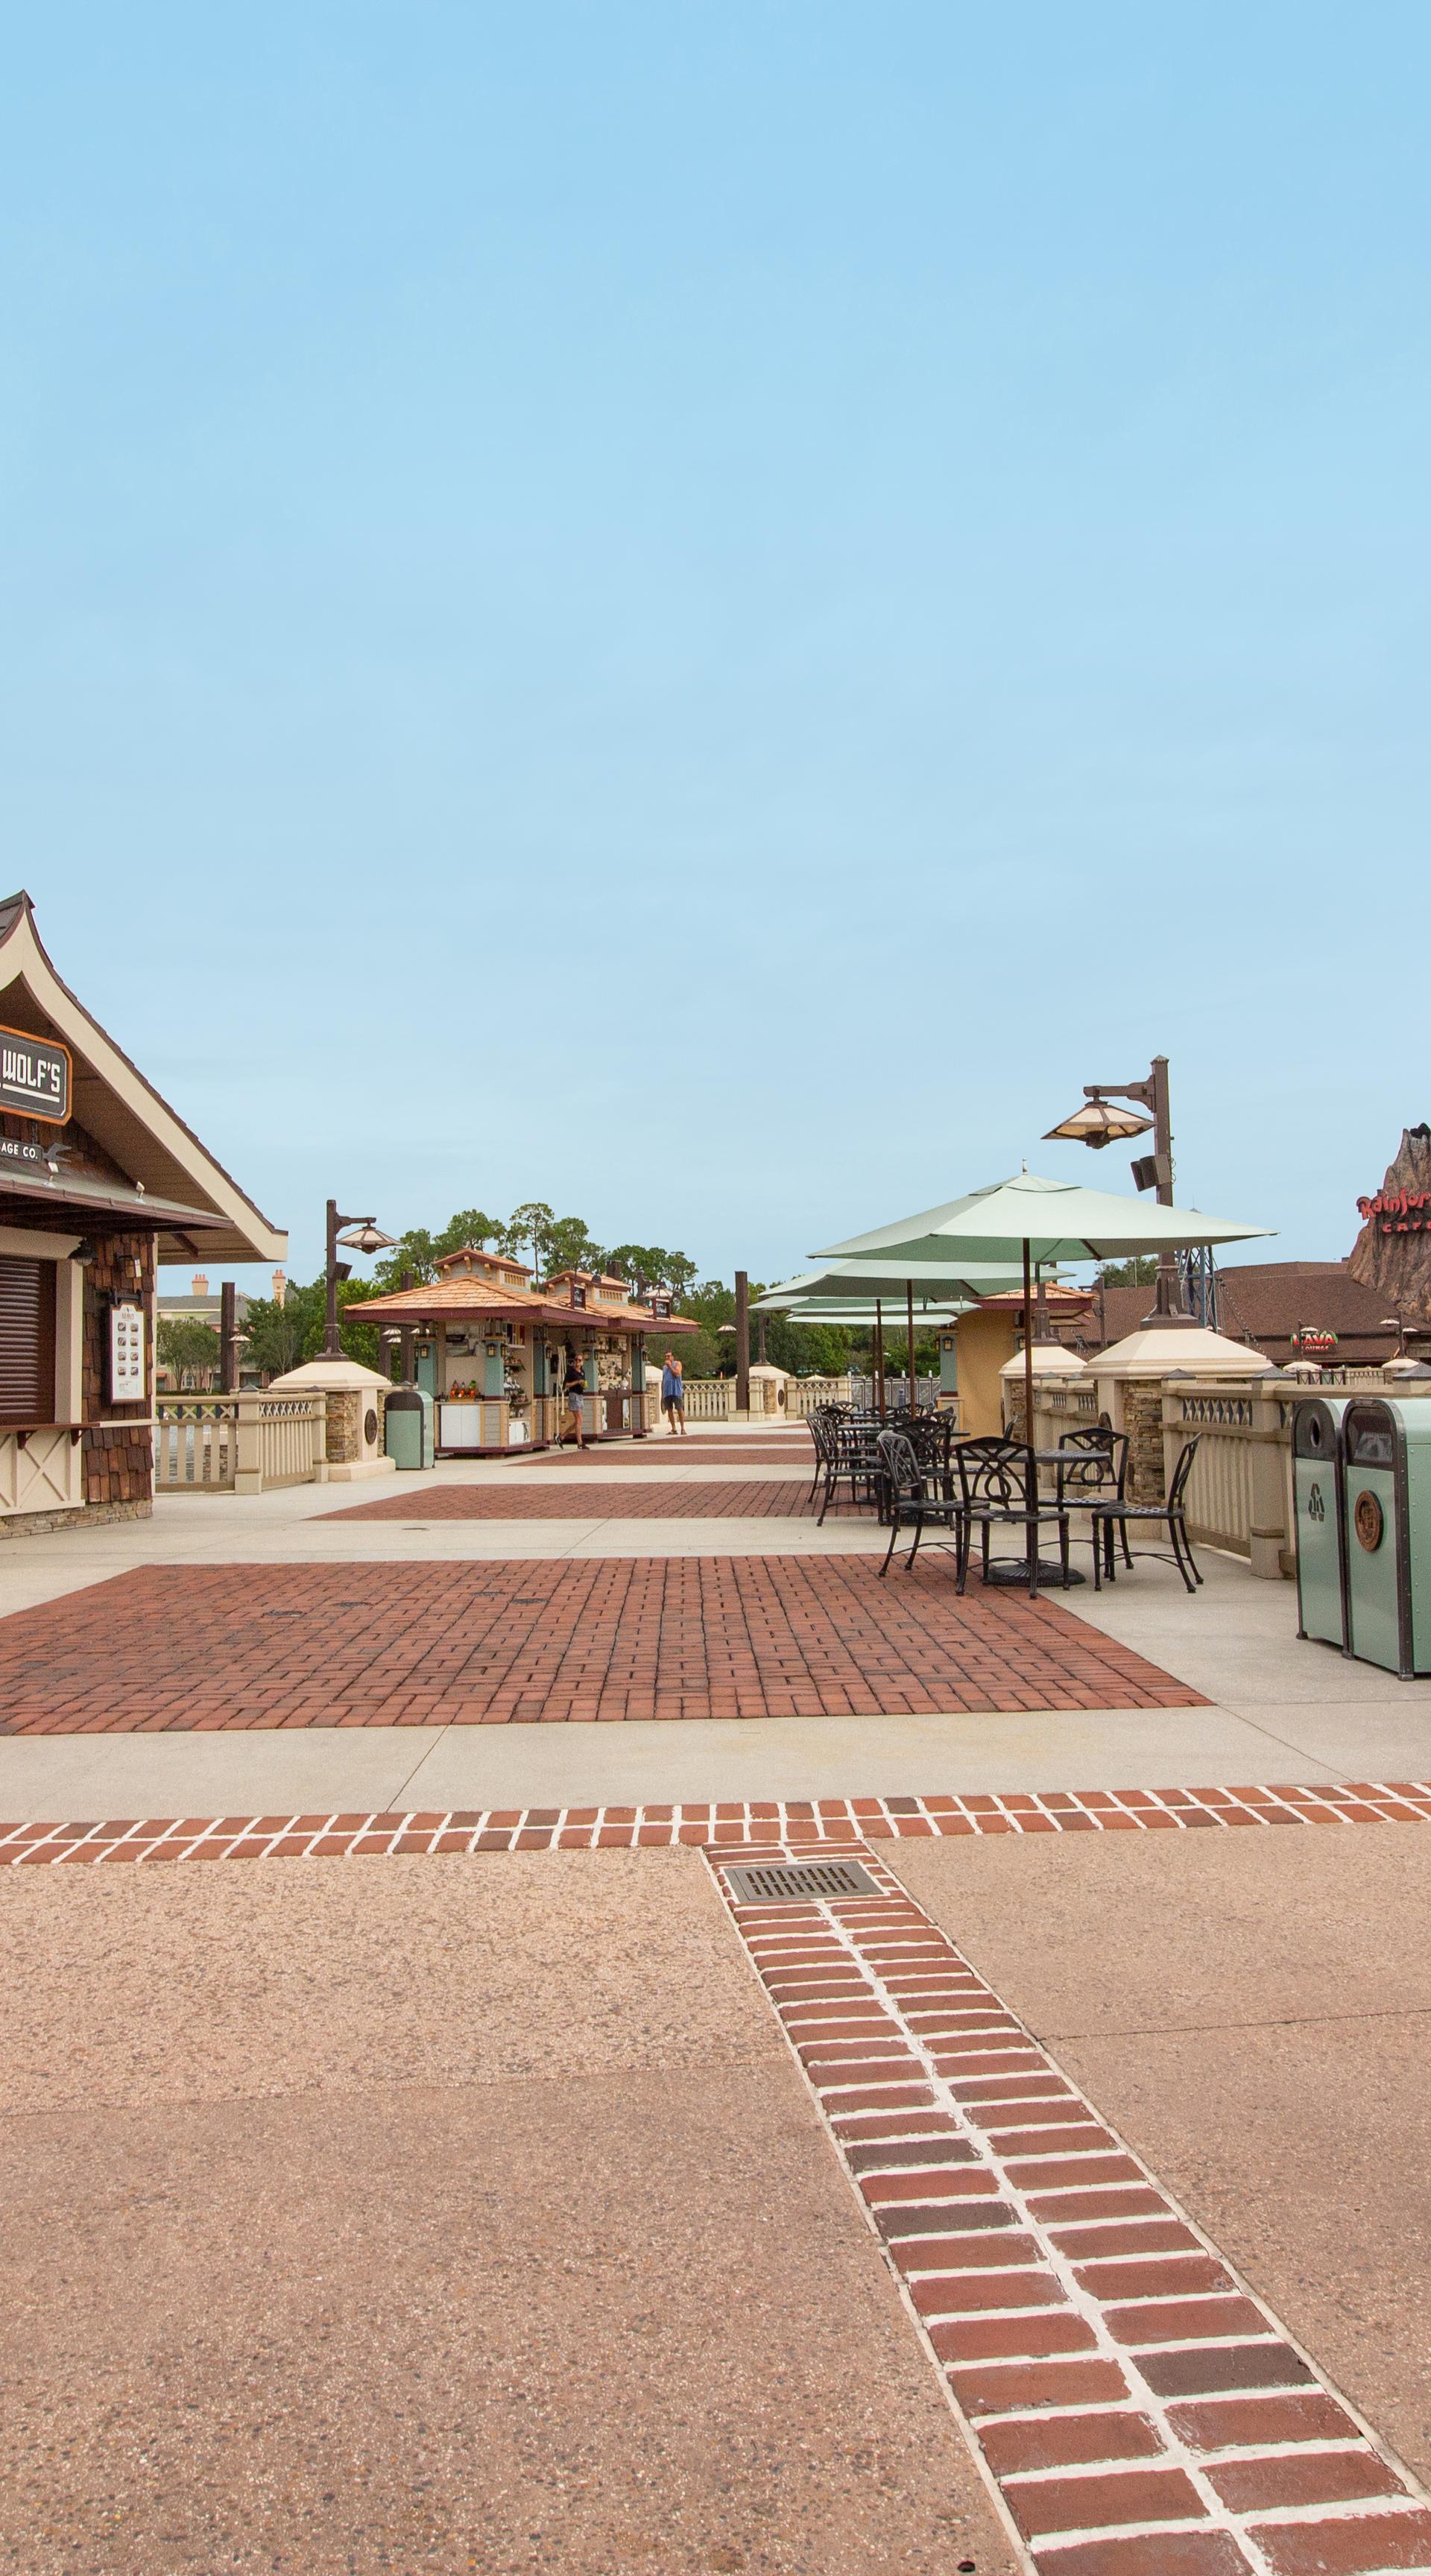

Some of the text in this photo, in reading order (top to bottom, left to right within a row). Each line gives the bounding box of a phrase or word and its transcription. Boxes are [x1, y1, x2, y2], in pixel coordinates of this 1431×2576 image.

[2, 1049, 60, 1093] WOLF'S
[0, 1141, 38, 1159] AGE CO.
[1356, 1187, 1431, 1220] Rainfor
[1292, 1333, 1336, 1346] LAVA
